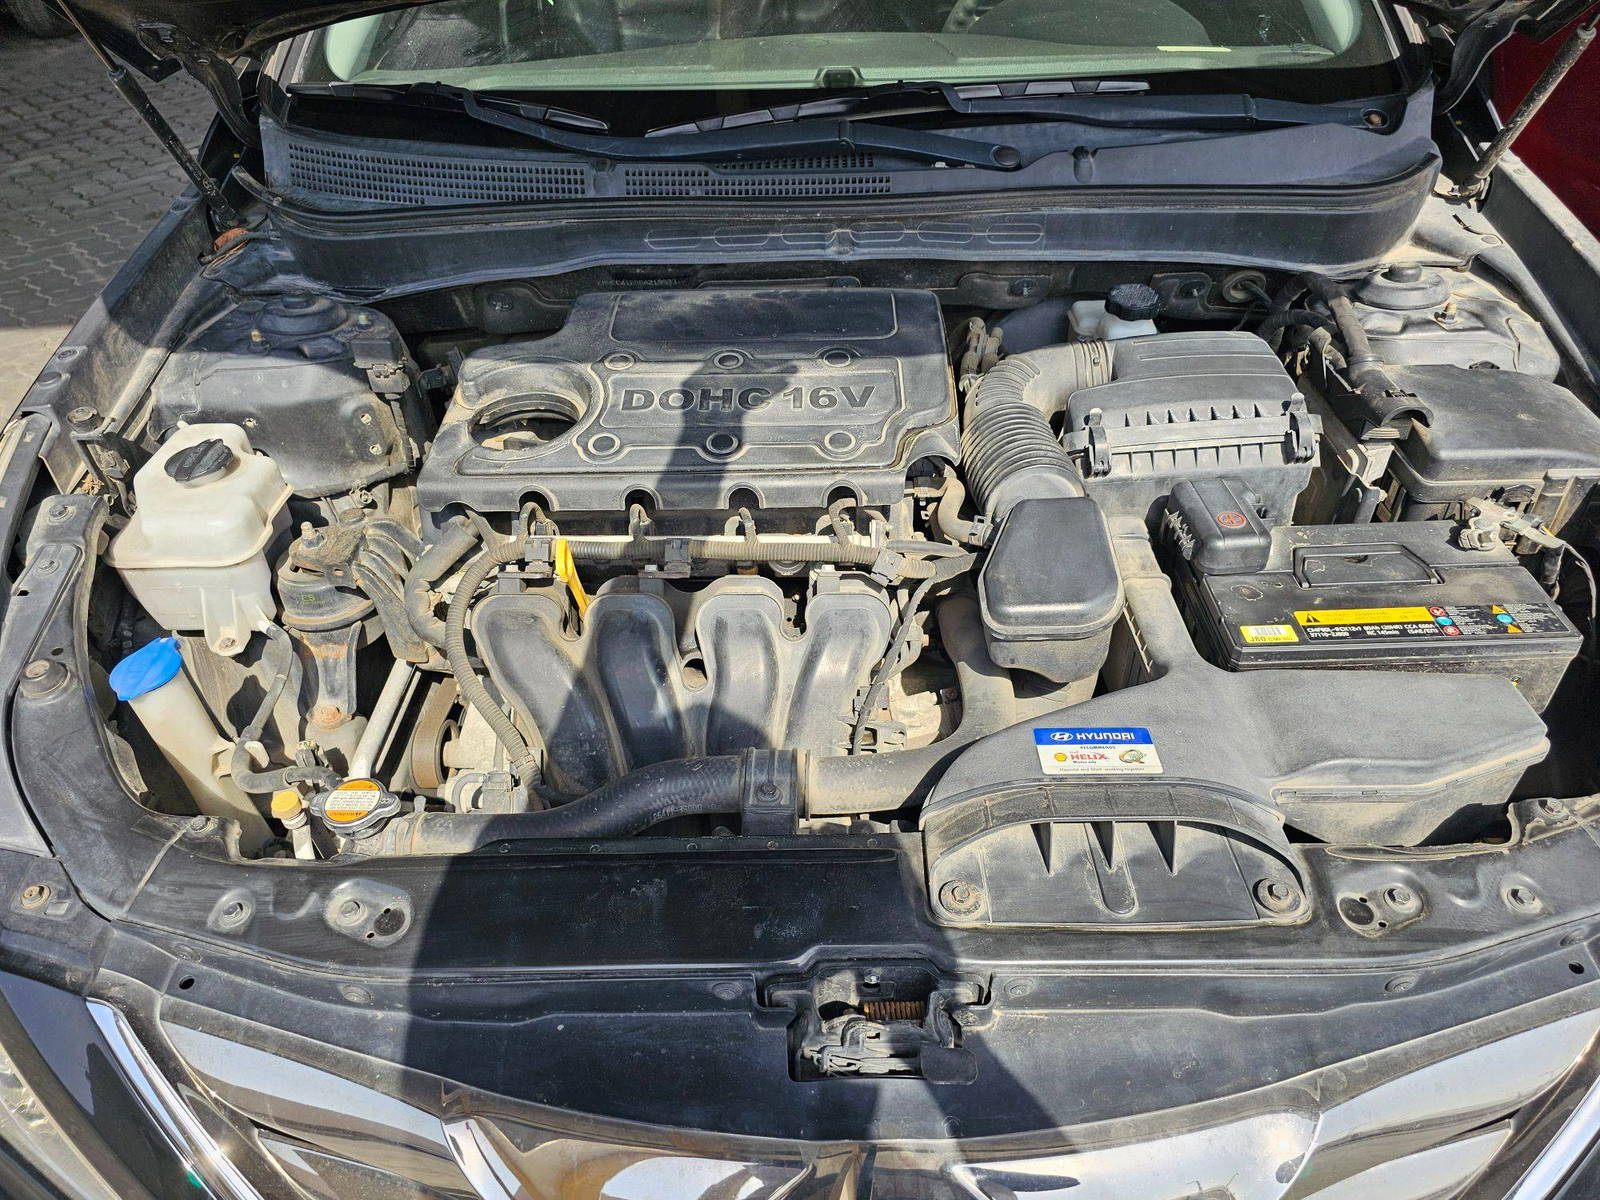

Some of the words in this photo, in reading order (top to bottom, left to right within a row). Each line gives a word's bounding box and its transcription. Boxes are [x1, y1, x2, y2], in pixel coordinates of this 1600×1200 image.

[620, 387, 773, 411] DOHC
[781, 385, 876, 410] 16V
[1077, 732, 1136, 740] HYUNDAI
